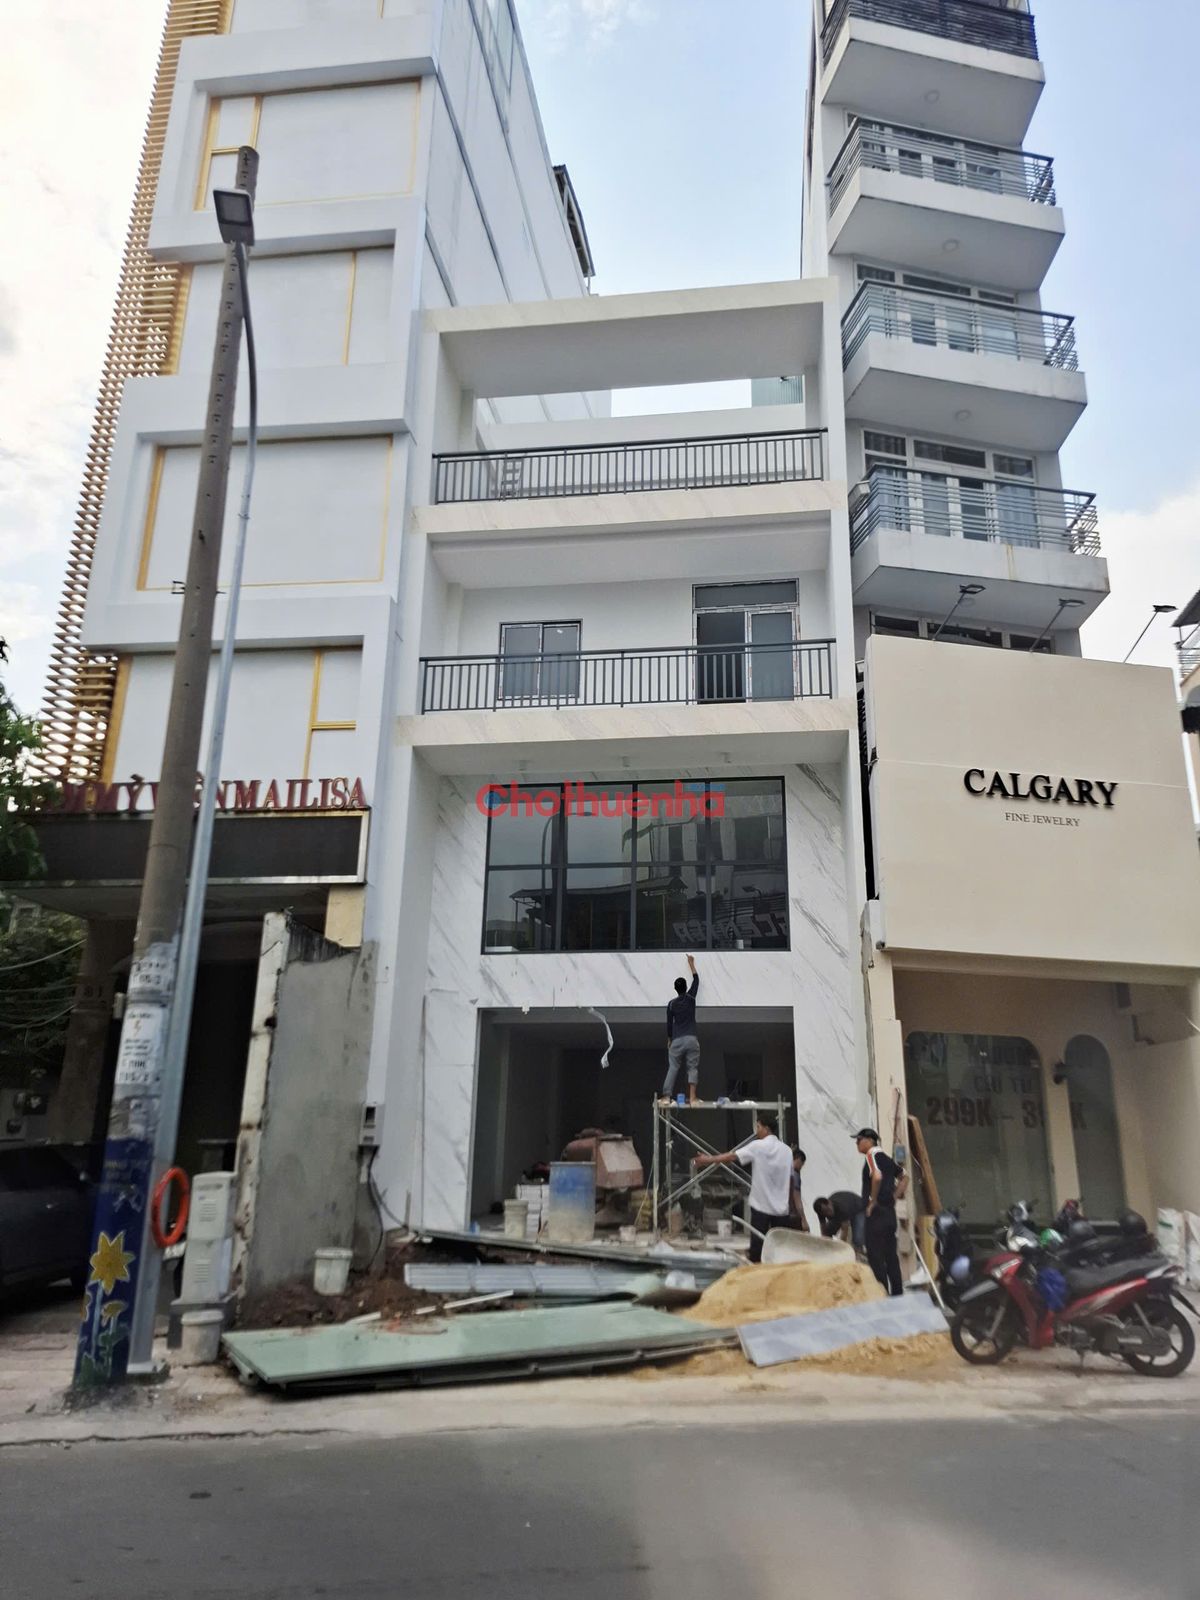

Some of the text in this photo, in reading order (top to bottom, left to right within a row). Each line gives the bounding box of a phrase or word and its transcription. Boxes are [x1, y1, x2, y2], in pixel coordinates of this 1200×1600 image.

[963, 768, 1118, 807] CALGARY
[1005, 812, 1080, 827] FINE JEWELRY
[926, 1096, 993, 1127] 299K
